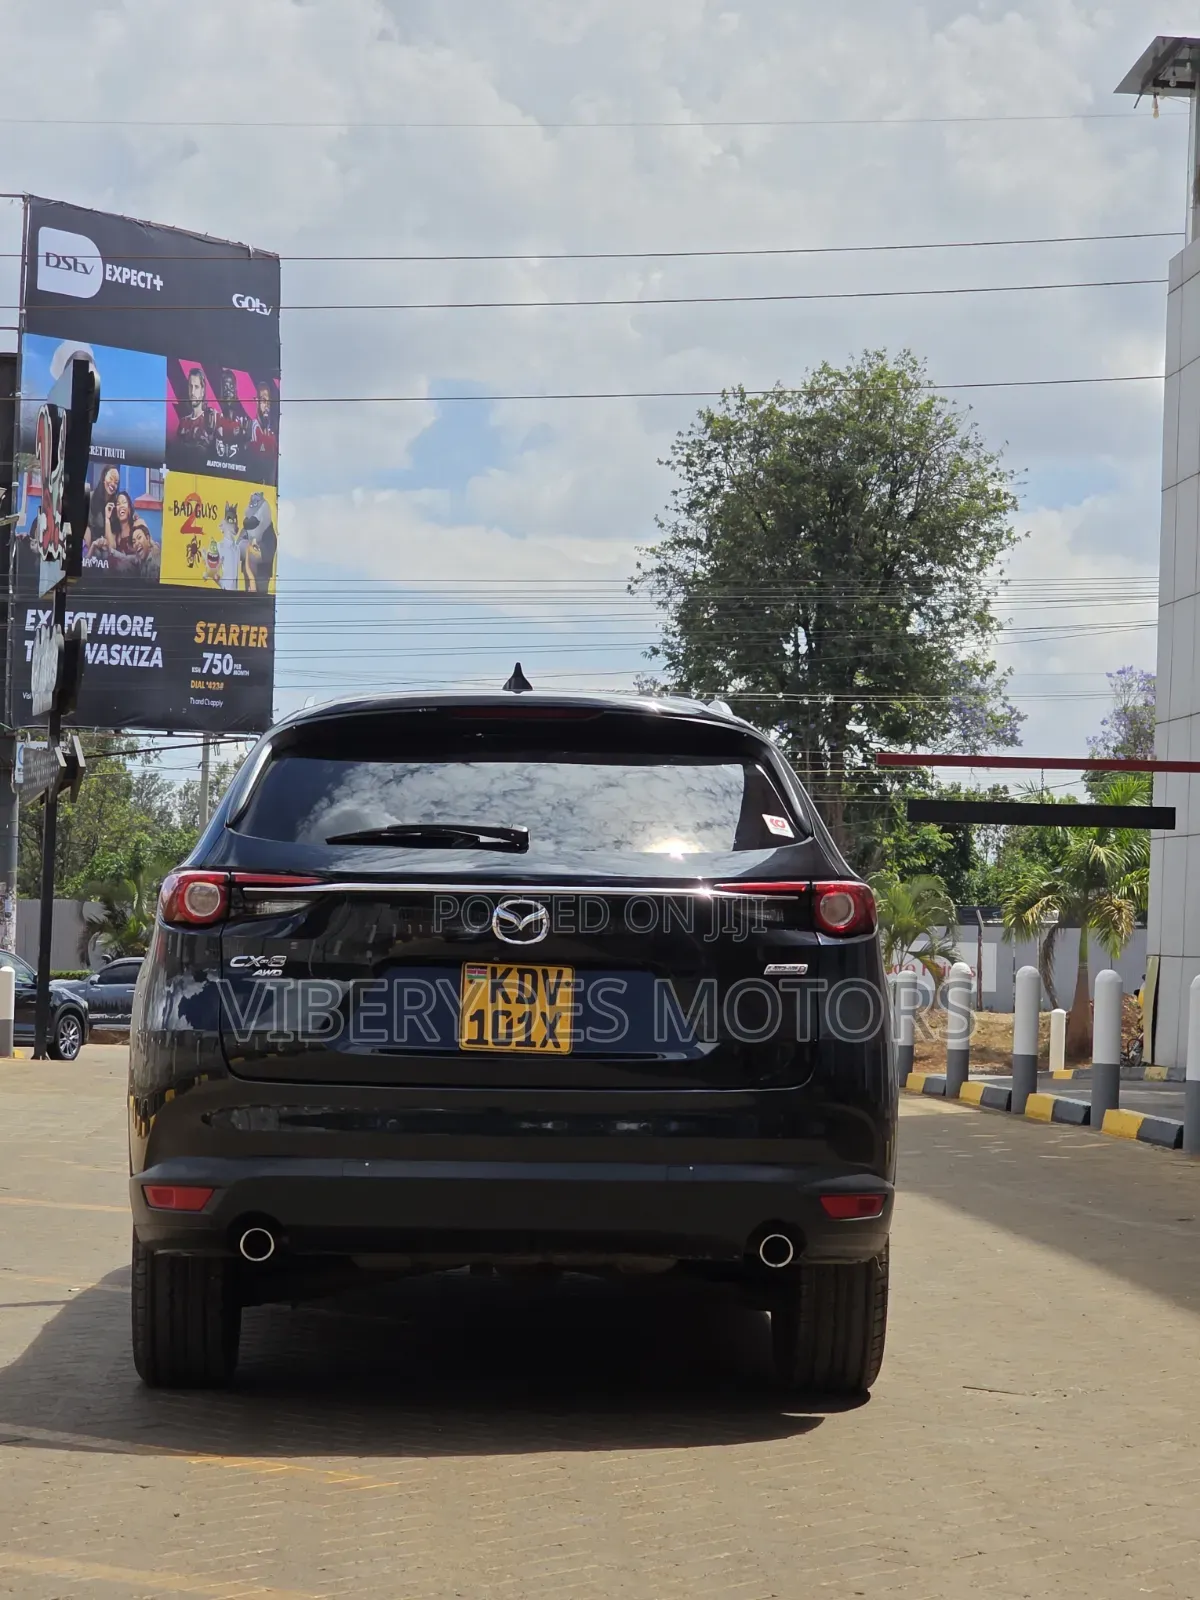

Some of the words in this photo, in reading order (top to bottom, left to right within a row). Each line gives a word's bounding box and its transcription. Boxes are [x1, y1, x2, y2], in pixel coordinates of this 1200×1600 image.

[45, 252, 95, 275] DStv
[173, 500, 193, 517] BAD
[195, 502, 218, 520] GUYS
[25, 609, 97, 634] EXECT
[98, 613, 158, 641] MORE,
[194, 621, 268, 648] STARTER
[202, 652, 234, 676] 750
[190, 680, 205, 689] DIAL
[229, 955, 287, 968] CX-8
[252, 969, 283, 977] AWD
[490, 966, 564, 1006] KDV
[465, 1008, 562, 1049] 101X
